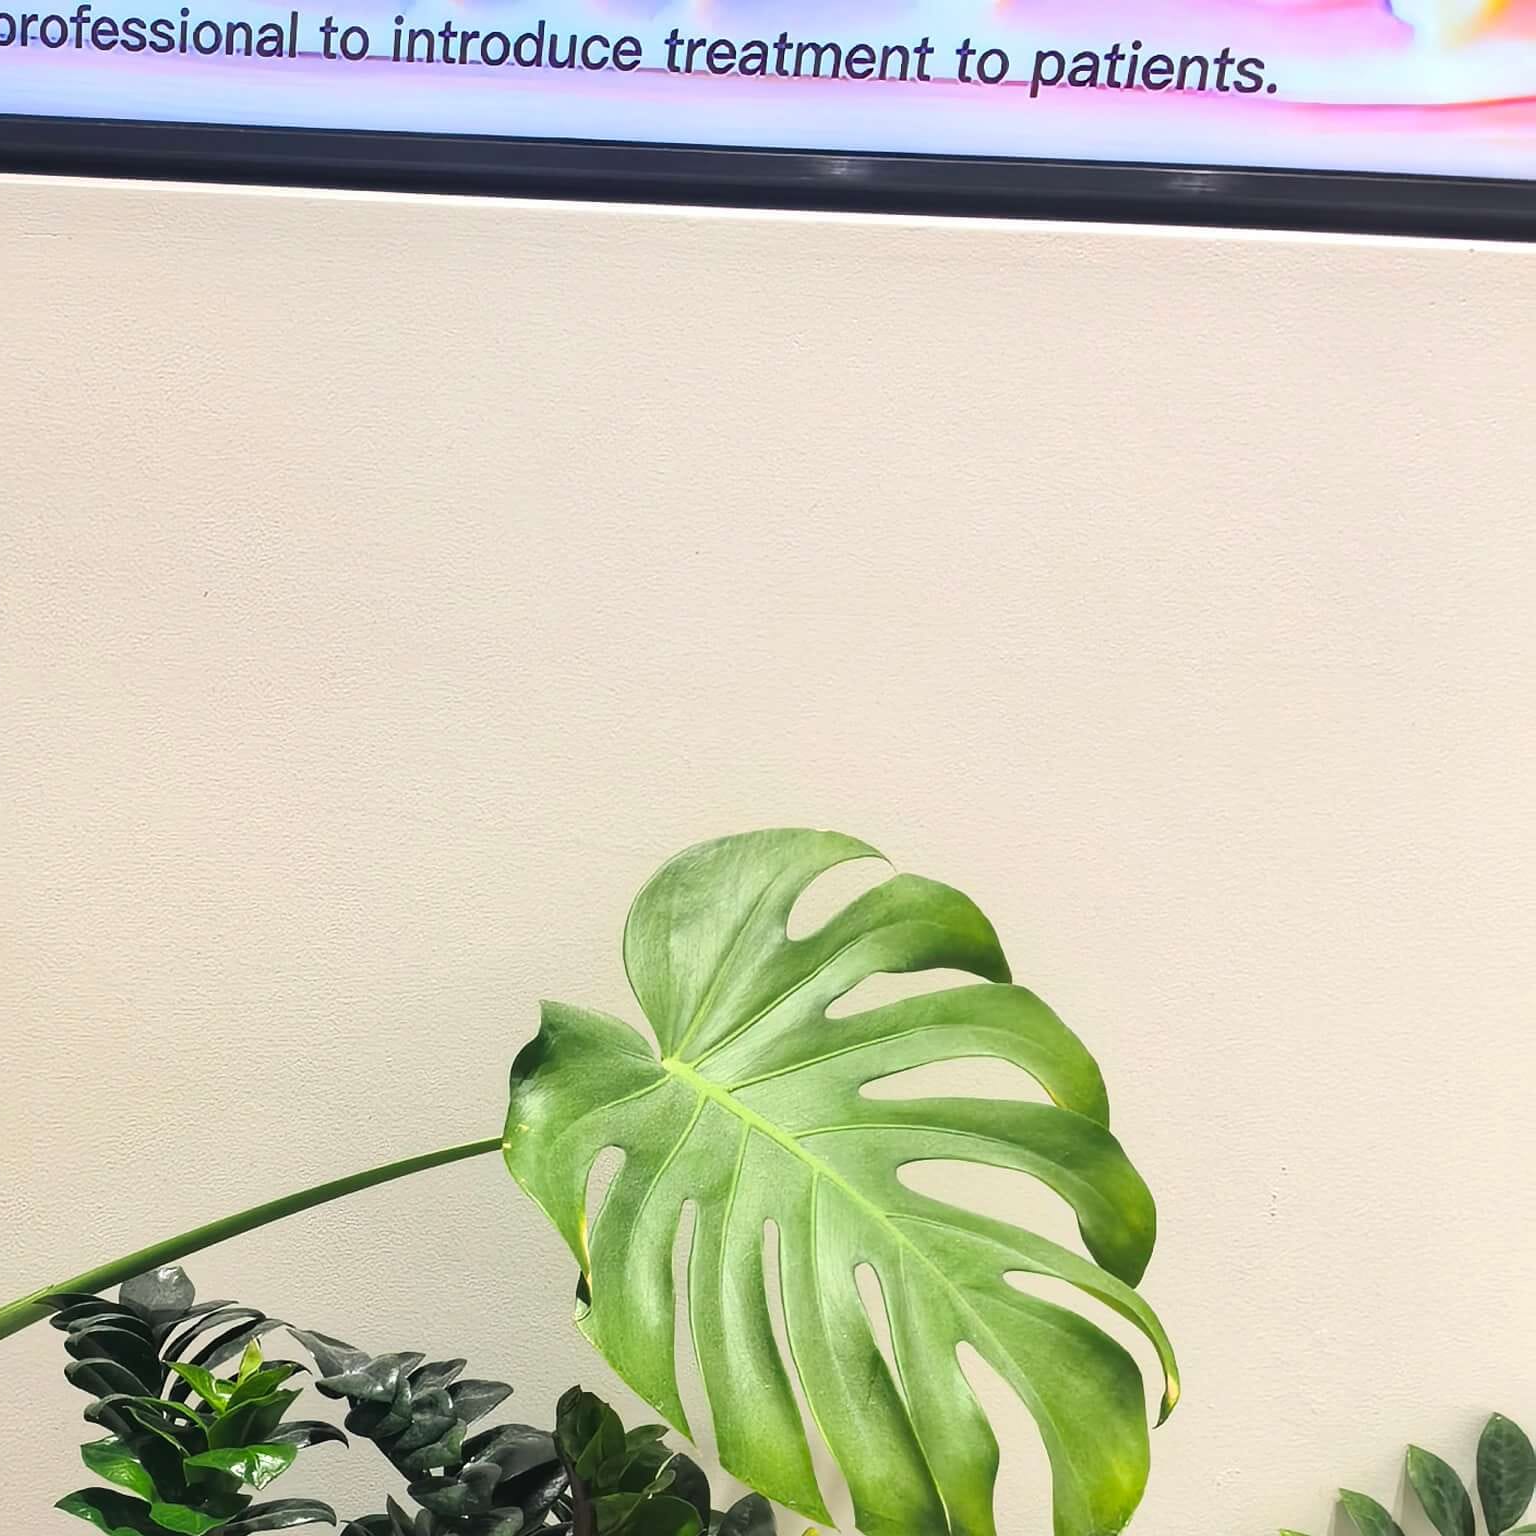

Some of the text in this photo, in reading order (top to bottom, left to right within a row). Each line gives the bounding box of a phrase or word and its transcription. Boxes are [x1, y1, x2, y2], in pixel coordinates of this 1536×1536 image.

[319, 15, 369, 61] to
[392, 18, 642, 78] introduce
[664, 28, 935, 82] treatment
[955, 38, 1010, 85] to
[1029, 42, 1280, 98] patients.
